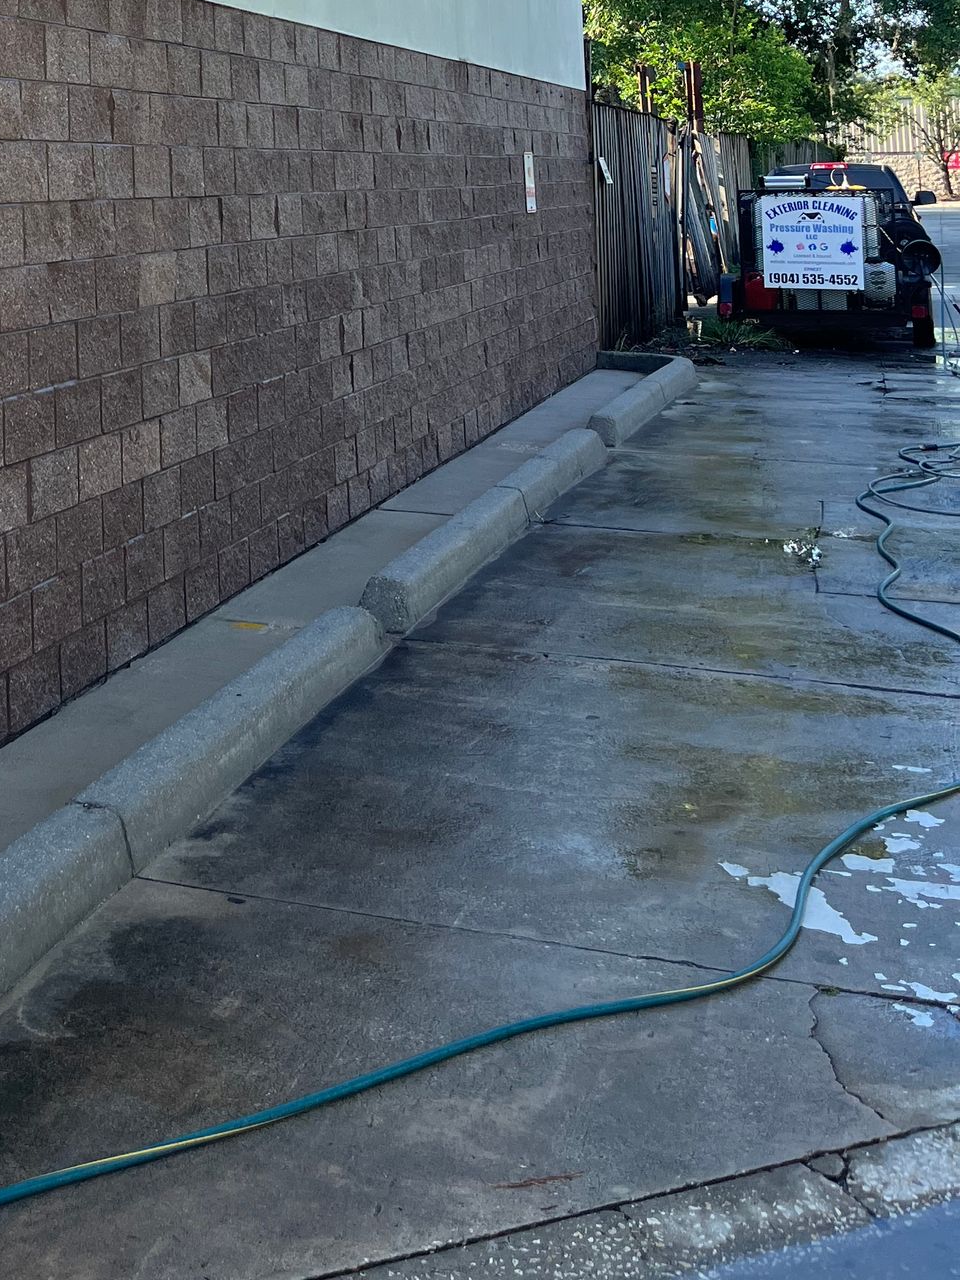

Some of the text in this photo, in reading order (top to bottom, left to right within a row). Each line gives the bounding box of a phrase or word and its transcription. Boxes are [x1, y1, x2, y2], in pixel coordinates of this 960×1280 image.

[765, 200, 858, 221] EXTERIOR CLEANING
[770, 223, 854, 234] Pressure Washing
[769, 273, 858, 285] (904) 535-4552
